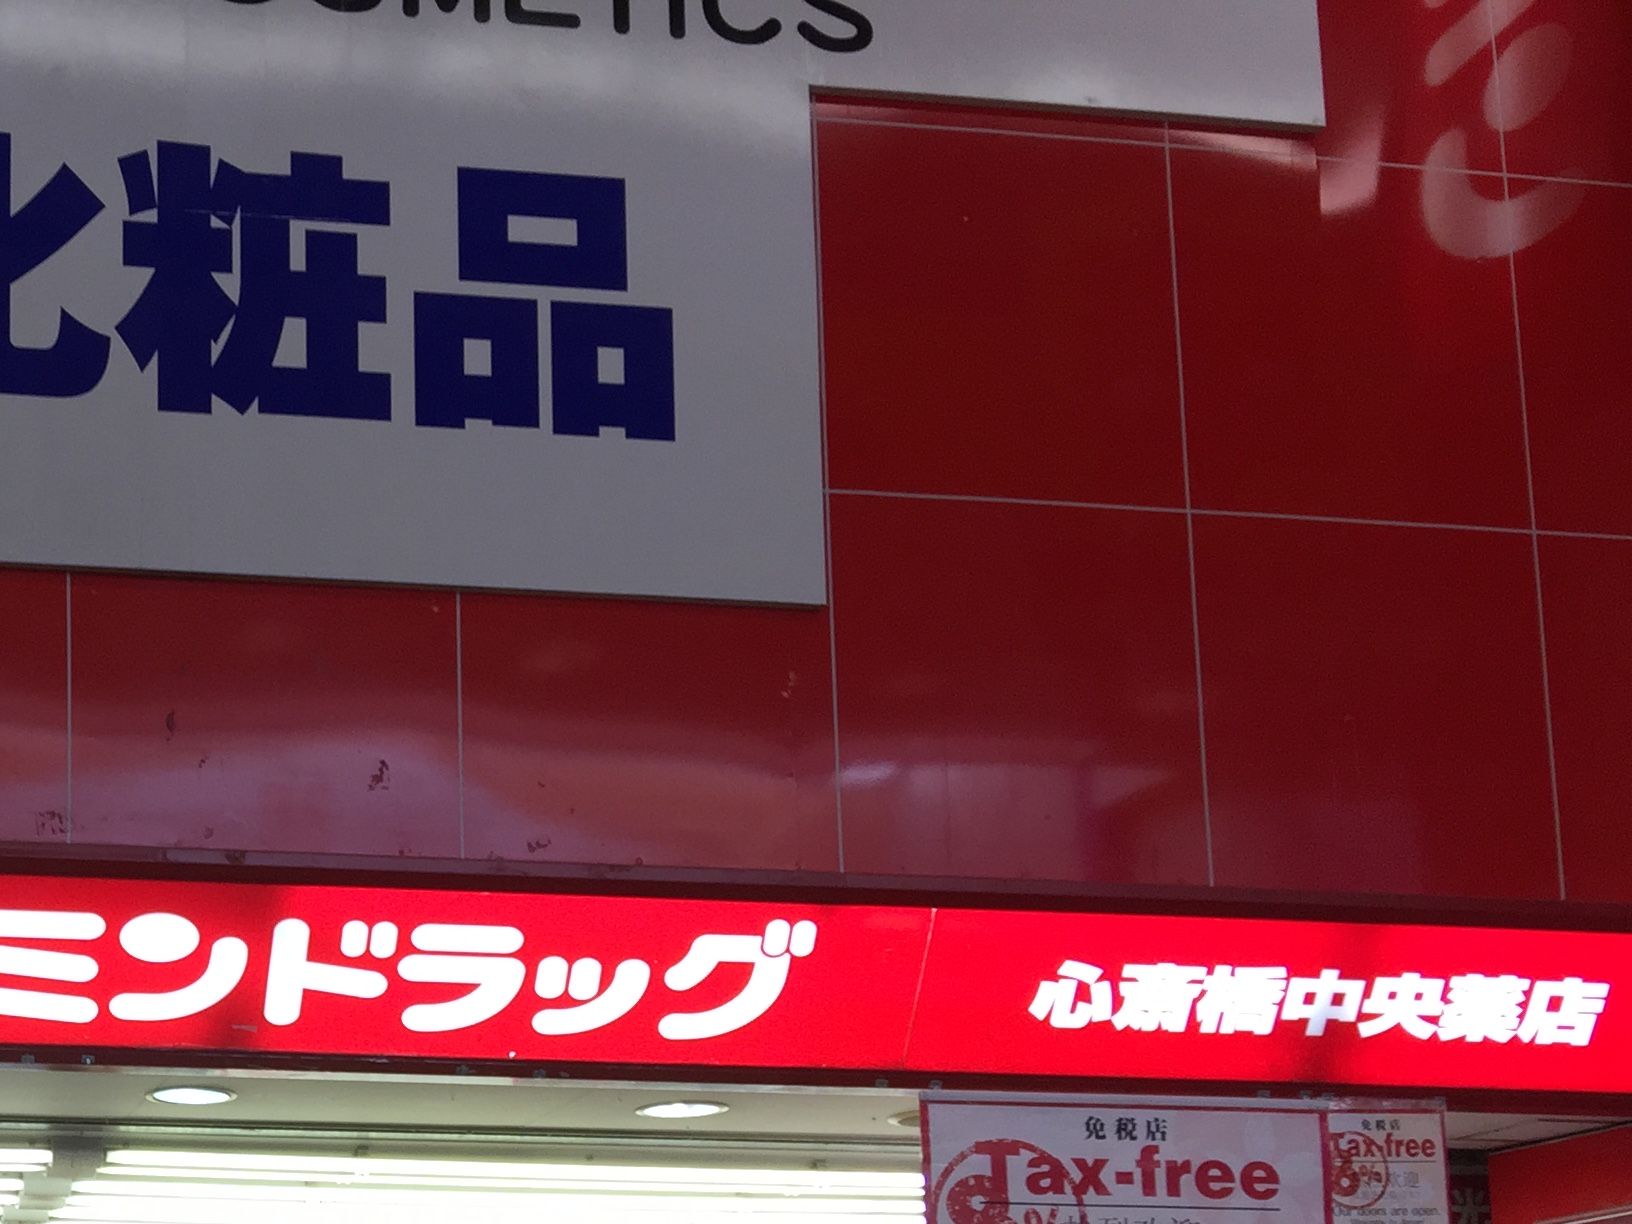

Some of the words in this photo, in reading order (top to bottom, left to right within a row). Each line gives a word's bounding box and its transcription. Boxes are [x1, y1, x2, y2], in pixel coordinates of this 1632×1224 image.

[1028, 960, 1611, 1047] 心斎橋中央薬店
[1085, 1116, 1168, 1142] 免税店
[973, 1140, 1281, 1200] Tax-free
